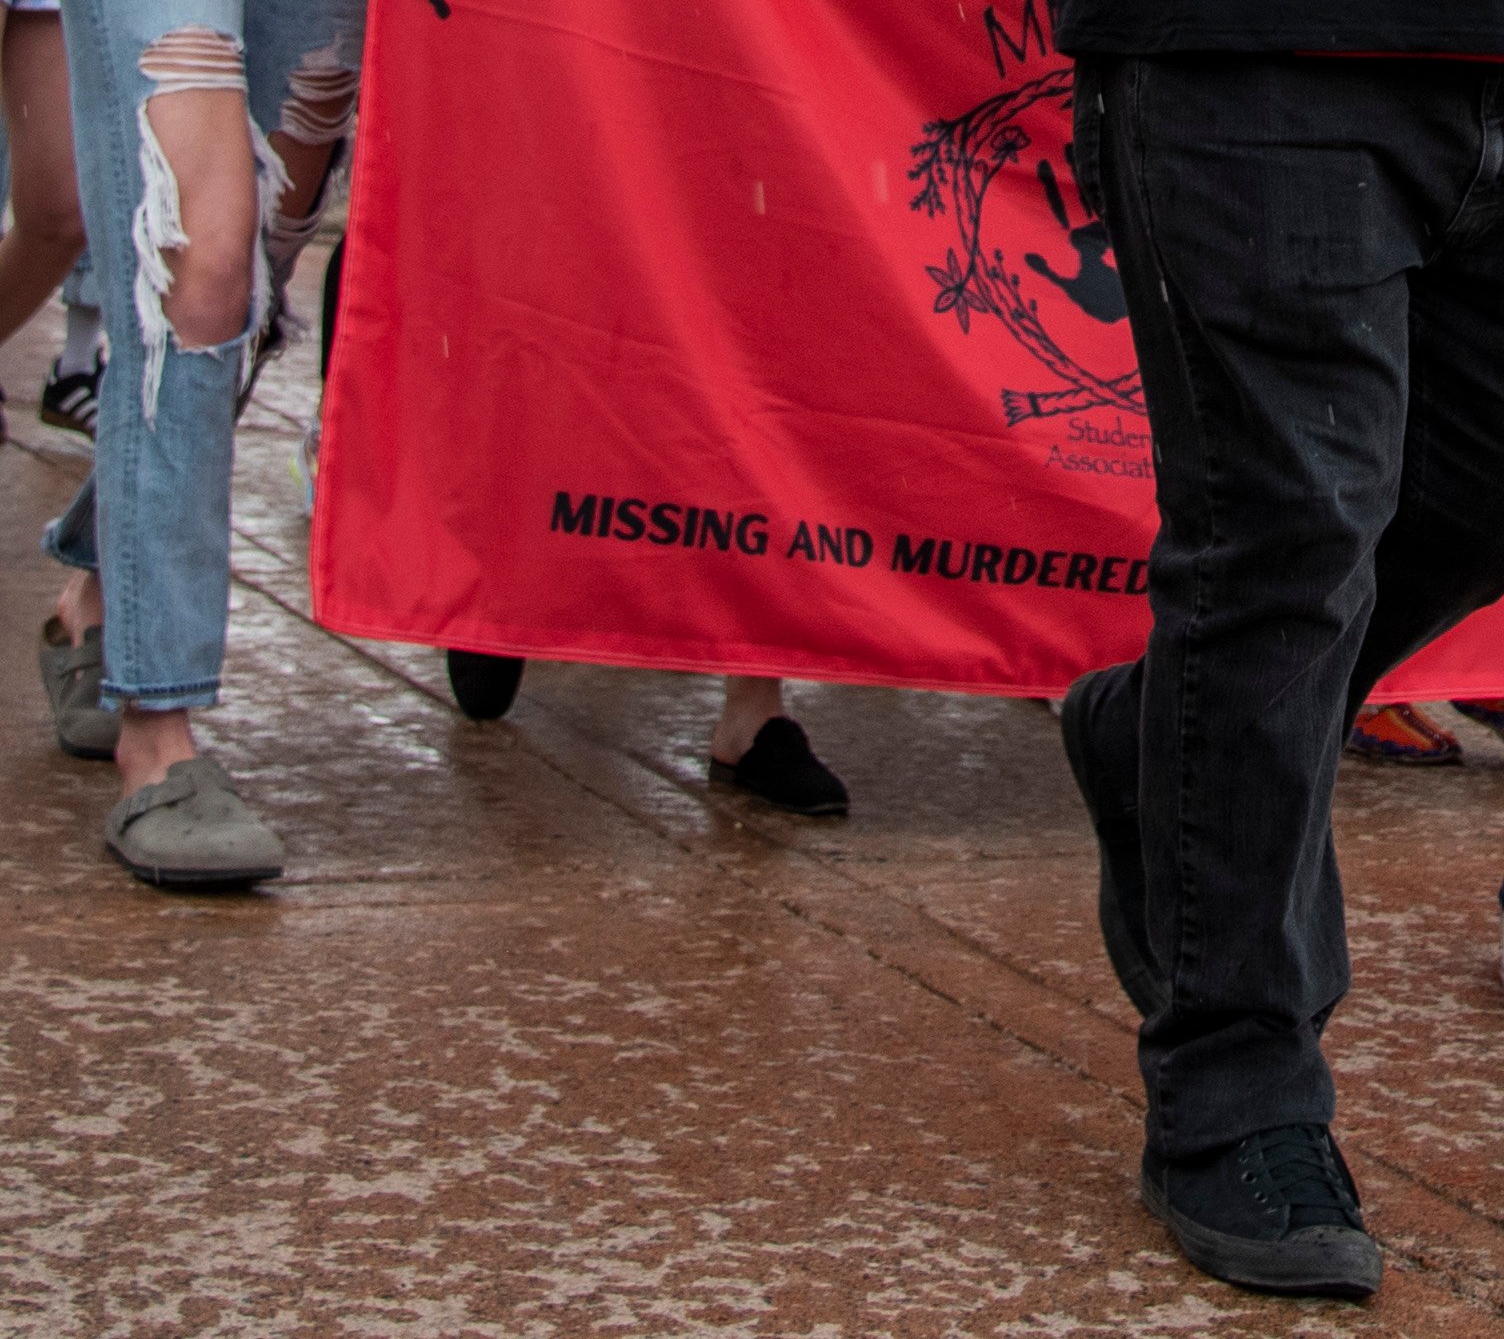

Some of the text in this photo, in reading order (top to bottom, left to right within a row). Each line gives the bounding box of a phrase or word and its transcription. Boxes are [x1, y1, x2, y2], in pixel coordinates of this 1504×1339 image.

[549, 490, 1150, 596] MISSING AND MURDERED
